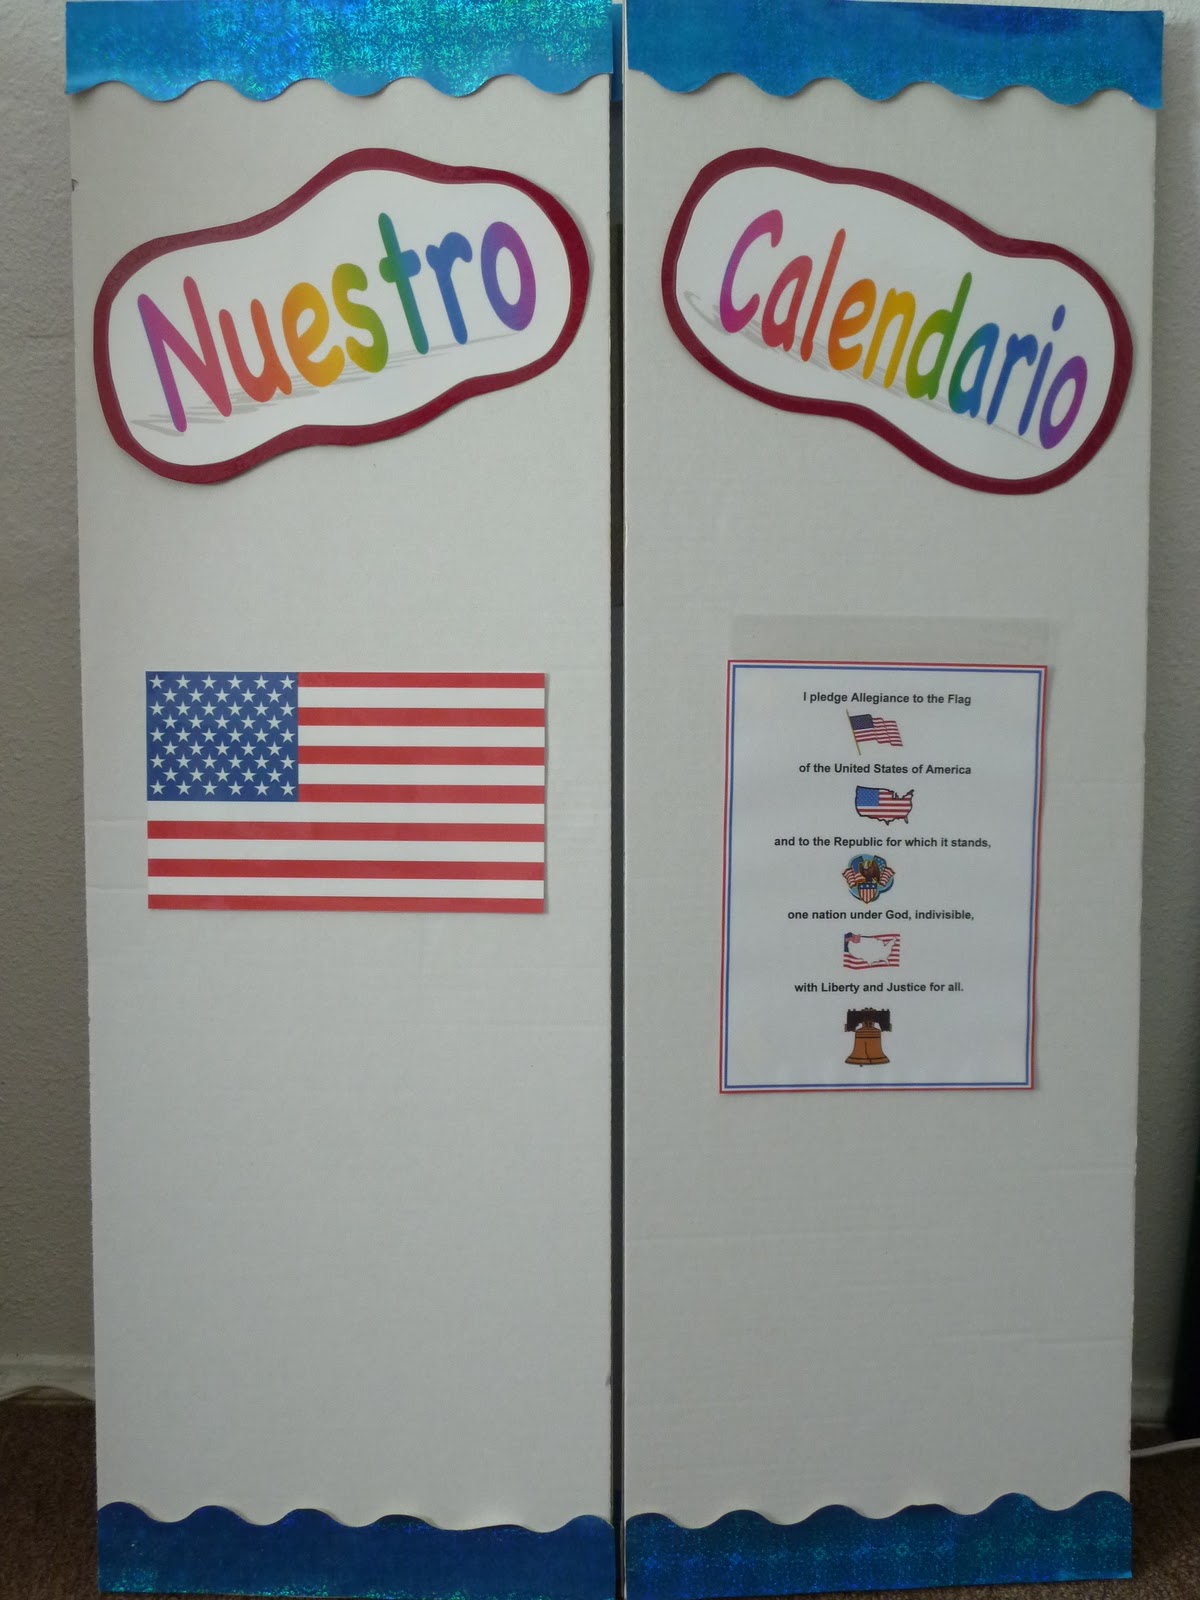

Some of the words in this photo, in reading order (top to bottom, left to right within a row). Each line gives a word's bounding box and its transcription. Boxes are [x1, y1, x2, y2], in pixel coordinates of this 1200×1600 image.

[138, 212, 537, 433] Nuestro
[719, 209, 1088, 449] Calendario
[809, 691, 849, 705] pledge
[850, 692, 910, 706] Allegiance
[912, 693, 925, 704] to
[926, 693, 945, 704] the
[947, 693, 972, 707] Flag
[798, 763, 811, 774] of
[813, 763, 831, 774] the
[834, 762, 871, 774] United
[873, 763, 909, 774] States
[911, 763, 924, 775] of
[925, 764, 972, 775] America
[773, 836, 796, 847] and
[797, 836, 810, 847] to
[812, 836, 831, 847] the
[833, 836, 884, 849] Republic
[885, 836, 903, 847] for
[904, 836, 938, 848] which
[940, 837, 949, 848] it
[950, 837, 992, 849] stands,
[787, 910, 809, 920] one
[811, 909, 847, 920] nation
[849, 909, 883, 920] under
[885, 909, 912, 922] God,
[914, 909, 975, 921] indivisible,
[793, 982, 818, 993] with
[820, 981, 861, 995] Liberty
[862, 981, 884, 993] and
[886, 981, 927, 993] Justice
[928, 981, 946, 992] for
[947, 981, 964, 992] all.
